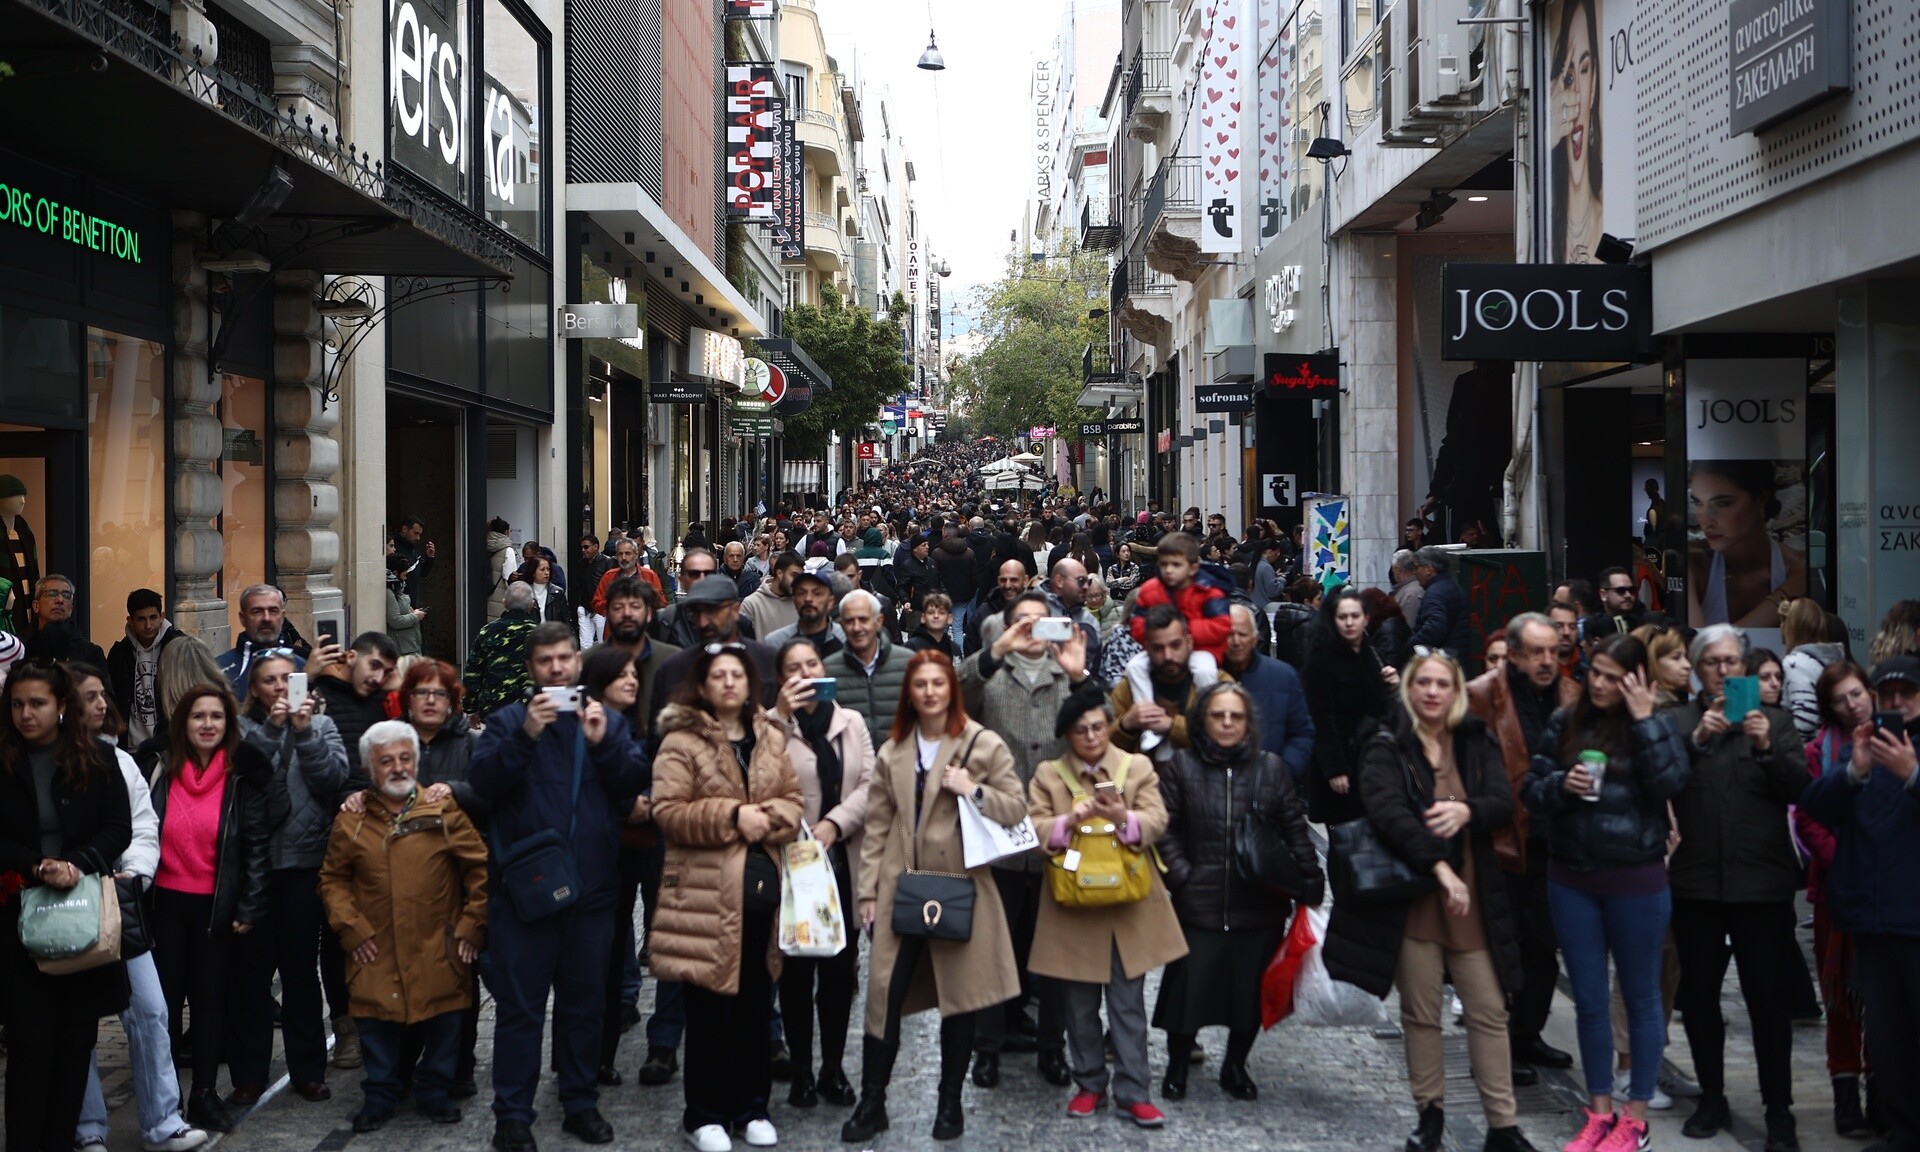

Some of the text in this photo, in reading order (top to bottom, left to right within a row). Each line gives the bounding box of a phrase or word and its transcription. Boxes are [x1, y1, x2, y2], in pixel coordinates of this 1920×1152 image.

[1735, 34, 1814, 110] ΣΑΚΕΛΛΑΡΗ
[735, 76, 766, 209] POP-AIR
[1037, 61, 1050, 205] ARKS & SPENCER
[36, 197, 59, 235] OF
[63, 205, 141, 263] BENETTON.
[1452, 288, 1629, 341] JOOLS
[1199, 392, 1249, 403] sofronas
[1697, 398, 1796, 430] JOOLS
[1083, 424, 1102, 435] BSB
[1107, 423, 1137, 431] parabita
[1880, 531, 1920, 551] ΣΑΚ
